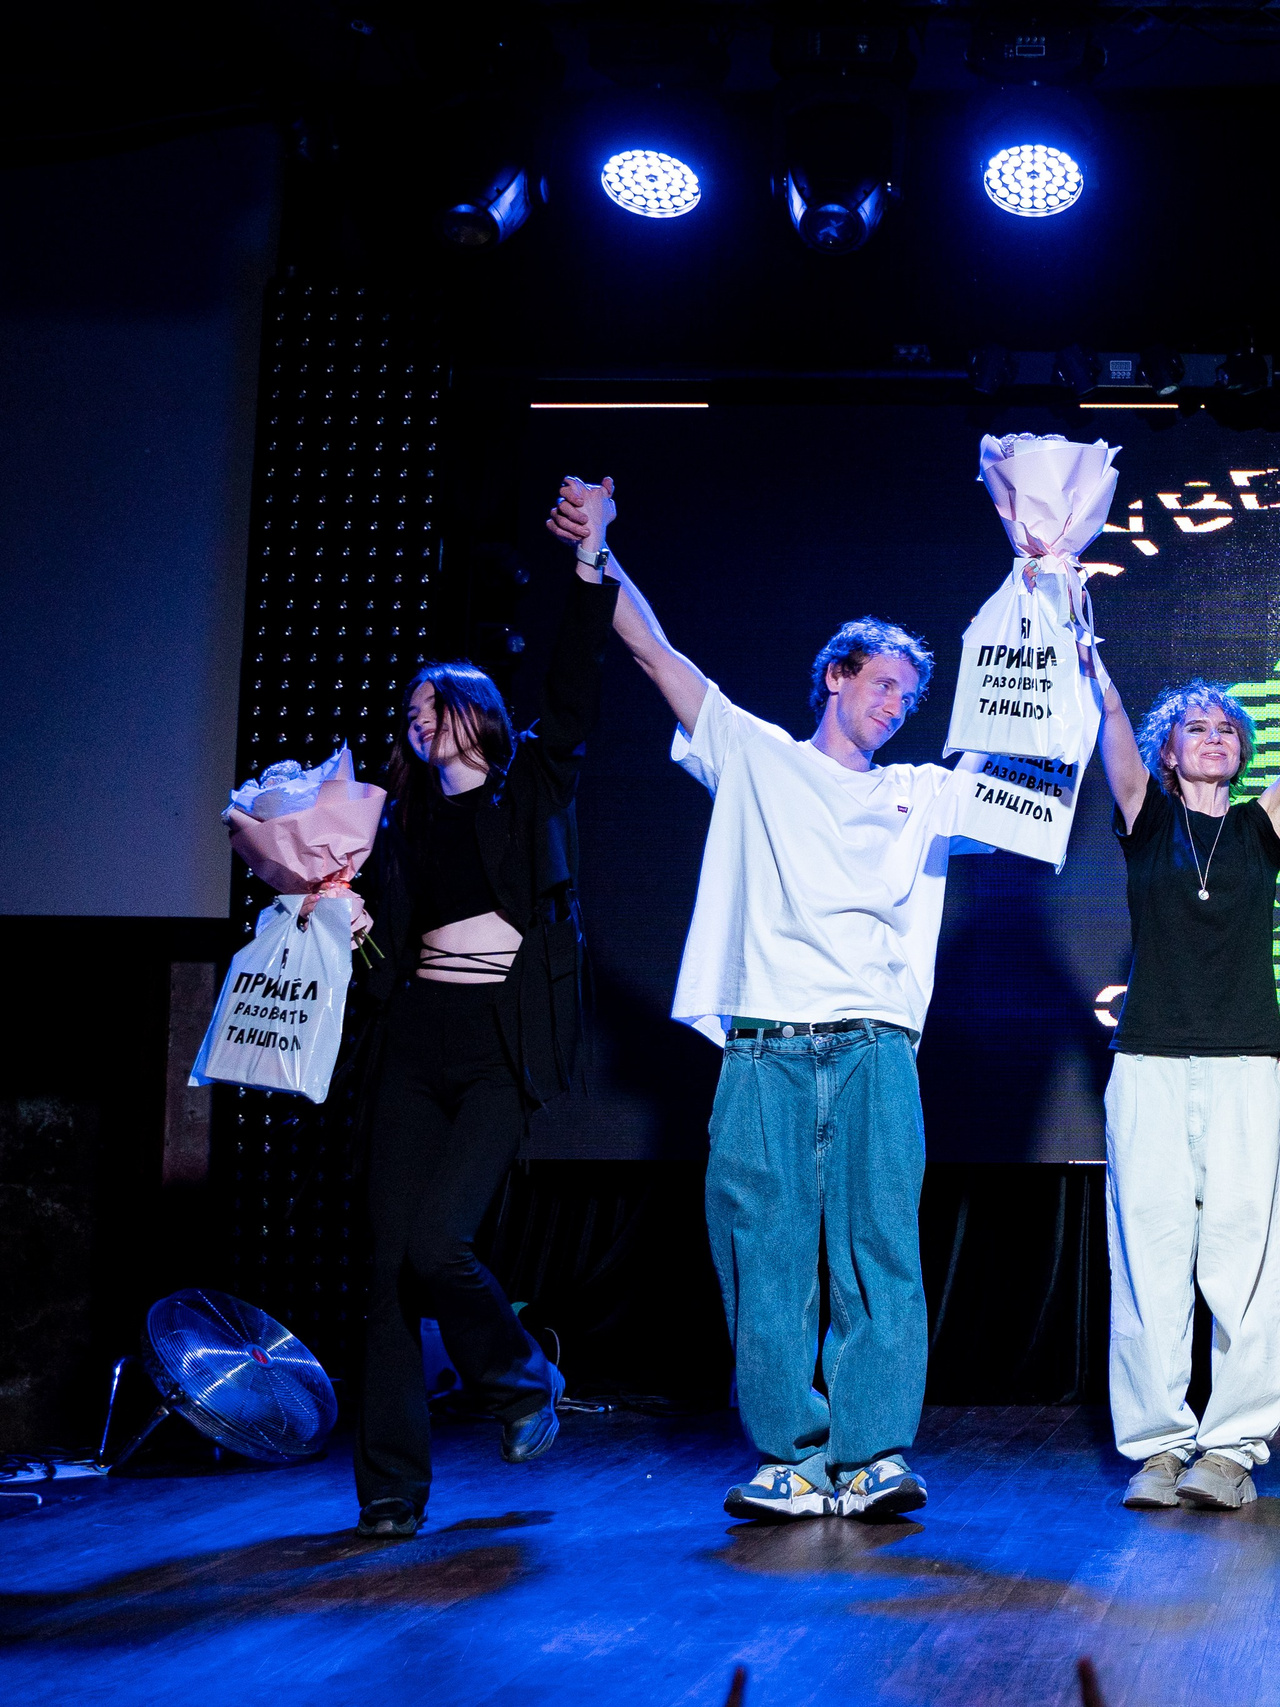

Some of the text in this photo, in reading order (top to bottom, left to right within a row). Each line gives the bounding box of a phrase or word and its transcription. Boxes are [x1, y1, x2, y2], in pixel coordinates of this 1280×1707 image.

[982, 760, 1063, 798] РАЗОРВАТЬ
[974, 782, 1053, 823] ТАНЦПОЛ
[226, 1024, 302, 1052] ТАНЦПОЛ
